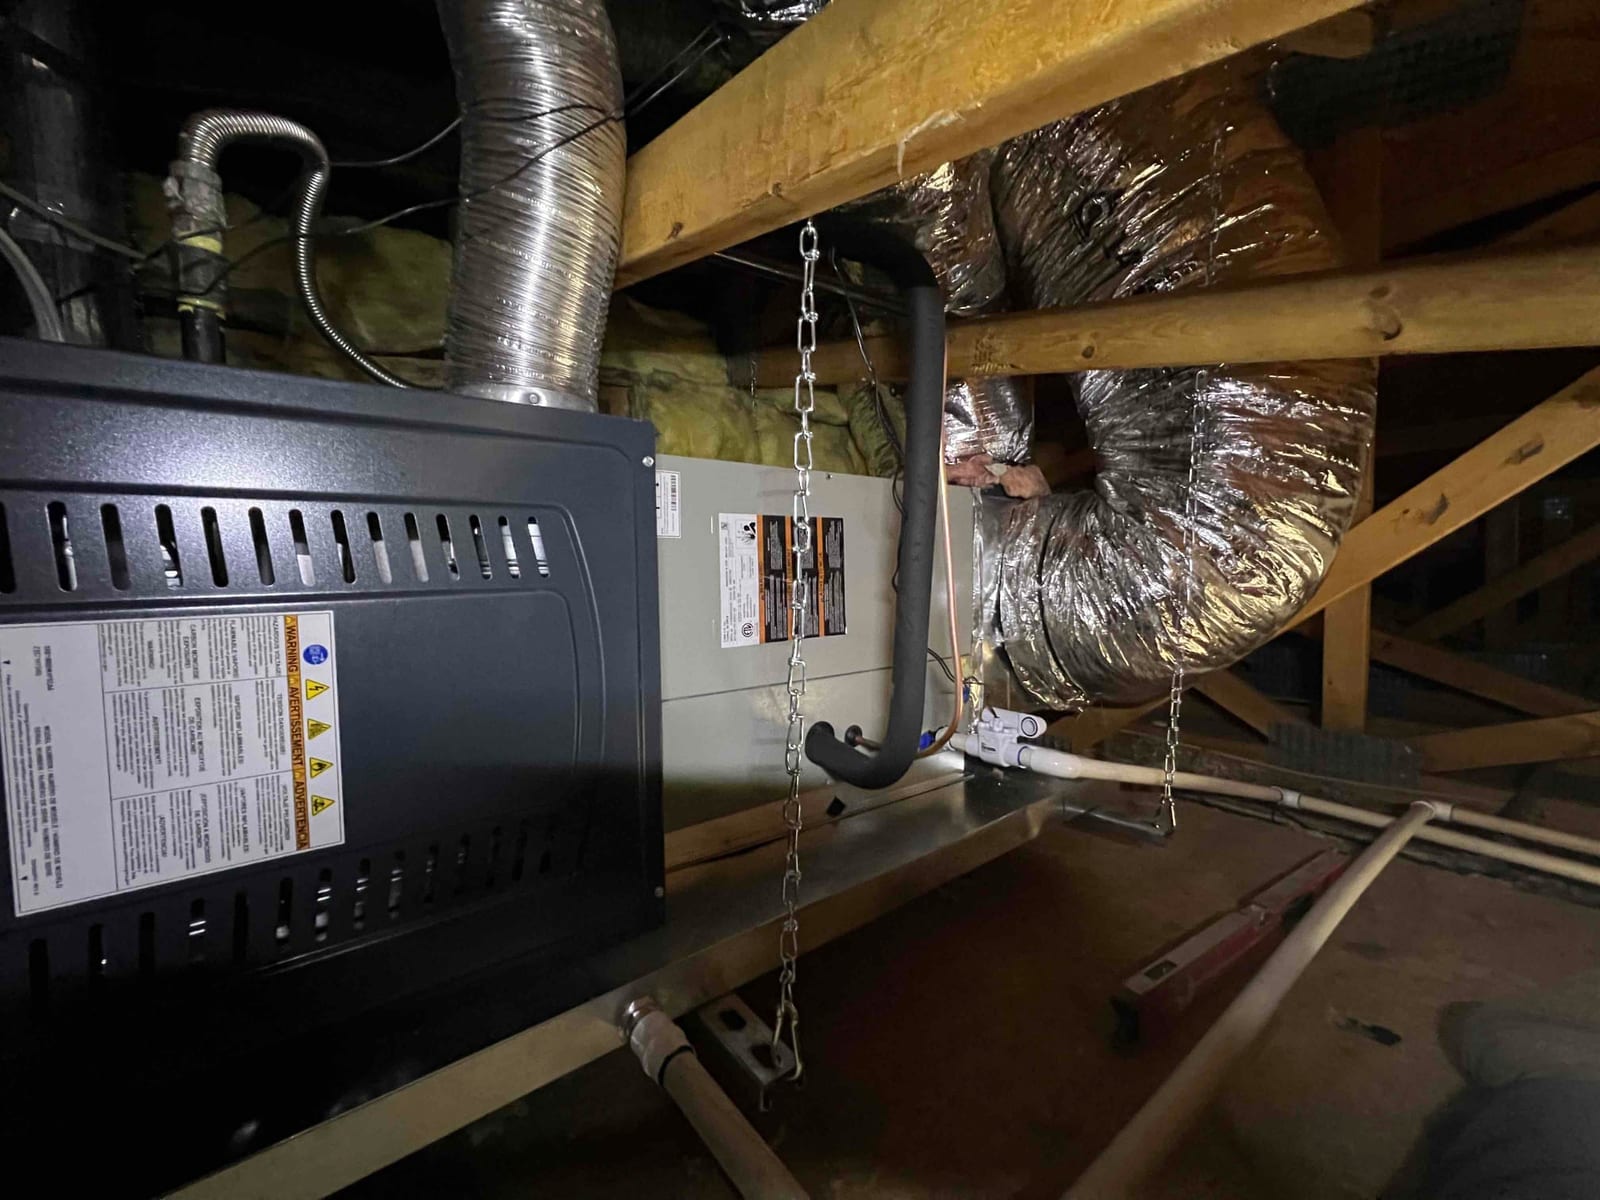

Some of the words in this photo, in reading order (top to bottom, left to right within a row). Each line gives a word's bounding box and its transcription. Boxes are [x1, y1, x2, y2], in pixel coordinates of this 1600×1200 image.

[287, 625, 298, 672] WARNING
[290, 686, 303, 766] AVERTISSEMENT
[294, 782, 308, 848] ADVERTENCIA
